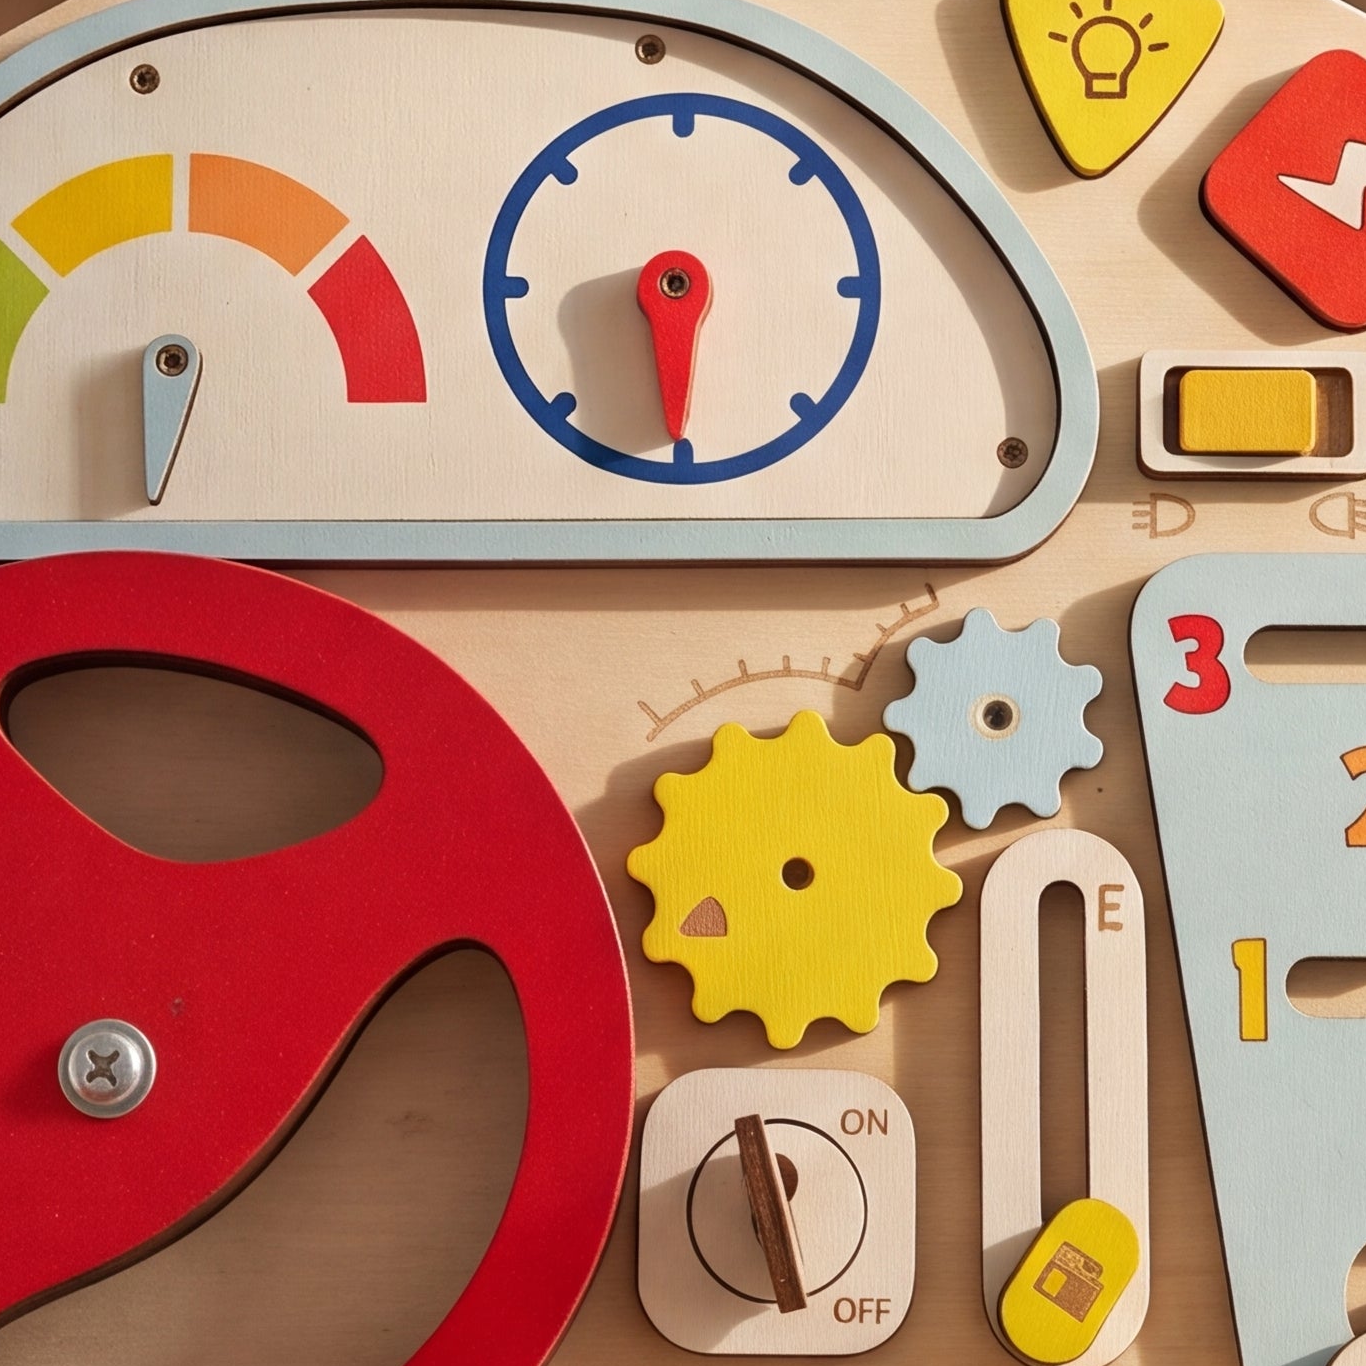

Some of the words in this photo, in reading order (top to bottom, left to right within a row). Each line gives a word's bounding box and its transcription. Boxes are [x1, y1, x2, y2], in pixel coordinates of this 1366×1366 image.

[1163, 614, 1232, 715] 3
[1098, 883, 1125, 932] E
[1231, 938, 1268, 1041] 1
[840, 1108, 888, 1135] ON
[833, 1297, 891, 1324] OFF
